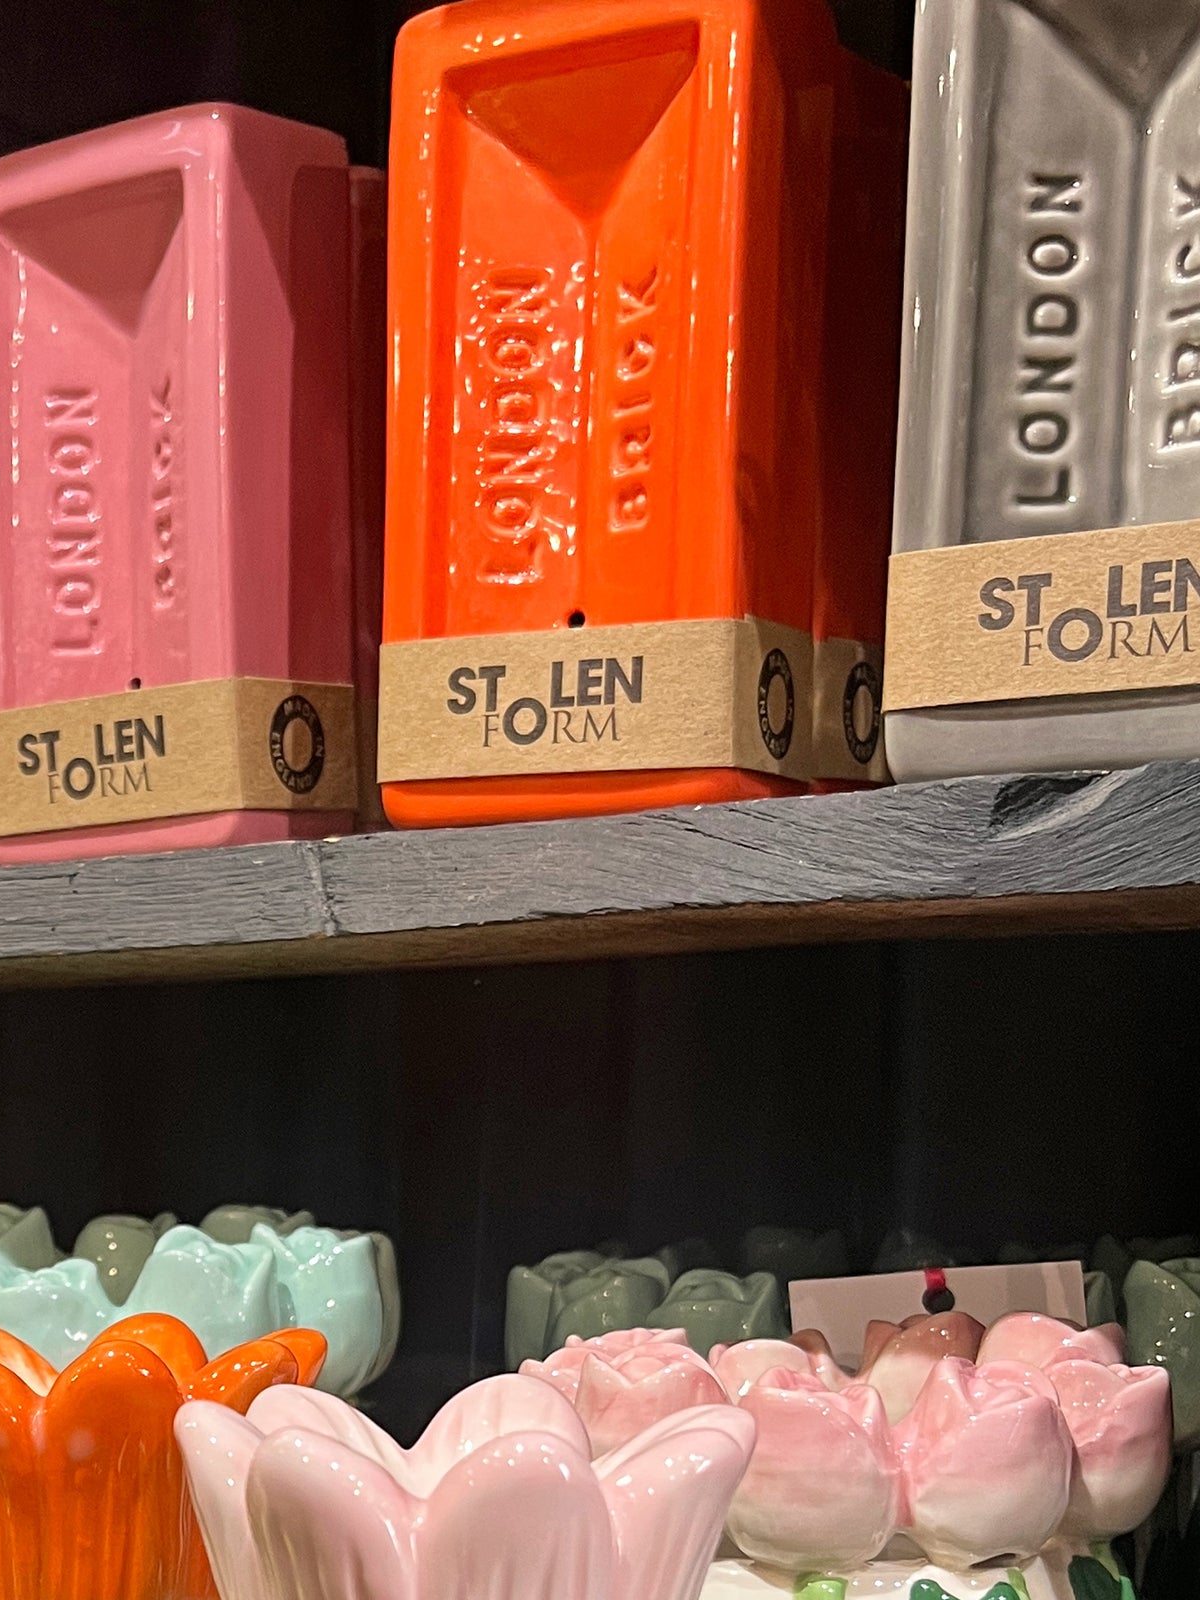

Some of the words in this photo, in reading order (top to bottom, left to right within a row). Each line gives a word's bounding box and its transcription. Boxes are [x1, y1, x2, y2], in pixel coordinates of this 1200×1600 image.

[1013, 172, 1081, 506] LONDON
[476, 266, 549, 585] LONDON
[608, 264, 658, 533] BRICK
[44, 386, 103, 657] LONDON
[1022, 608, 1195, 666] FORM
[447, 655, 644, 745] STOLEN
[482, 697, 621, 748] FORM
[18, 715, 166, 800] STOLEN
[47, 757, 153, 804] FORM
